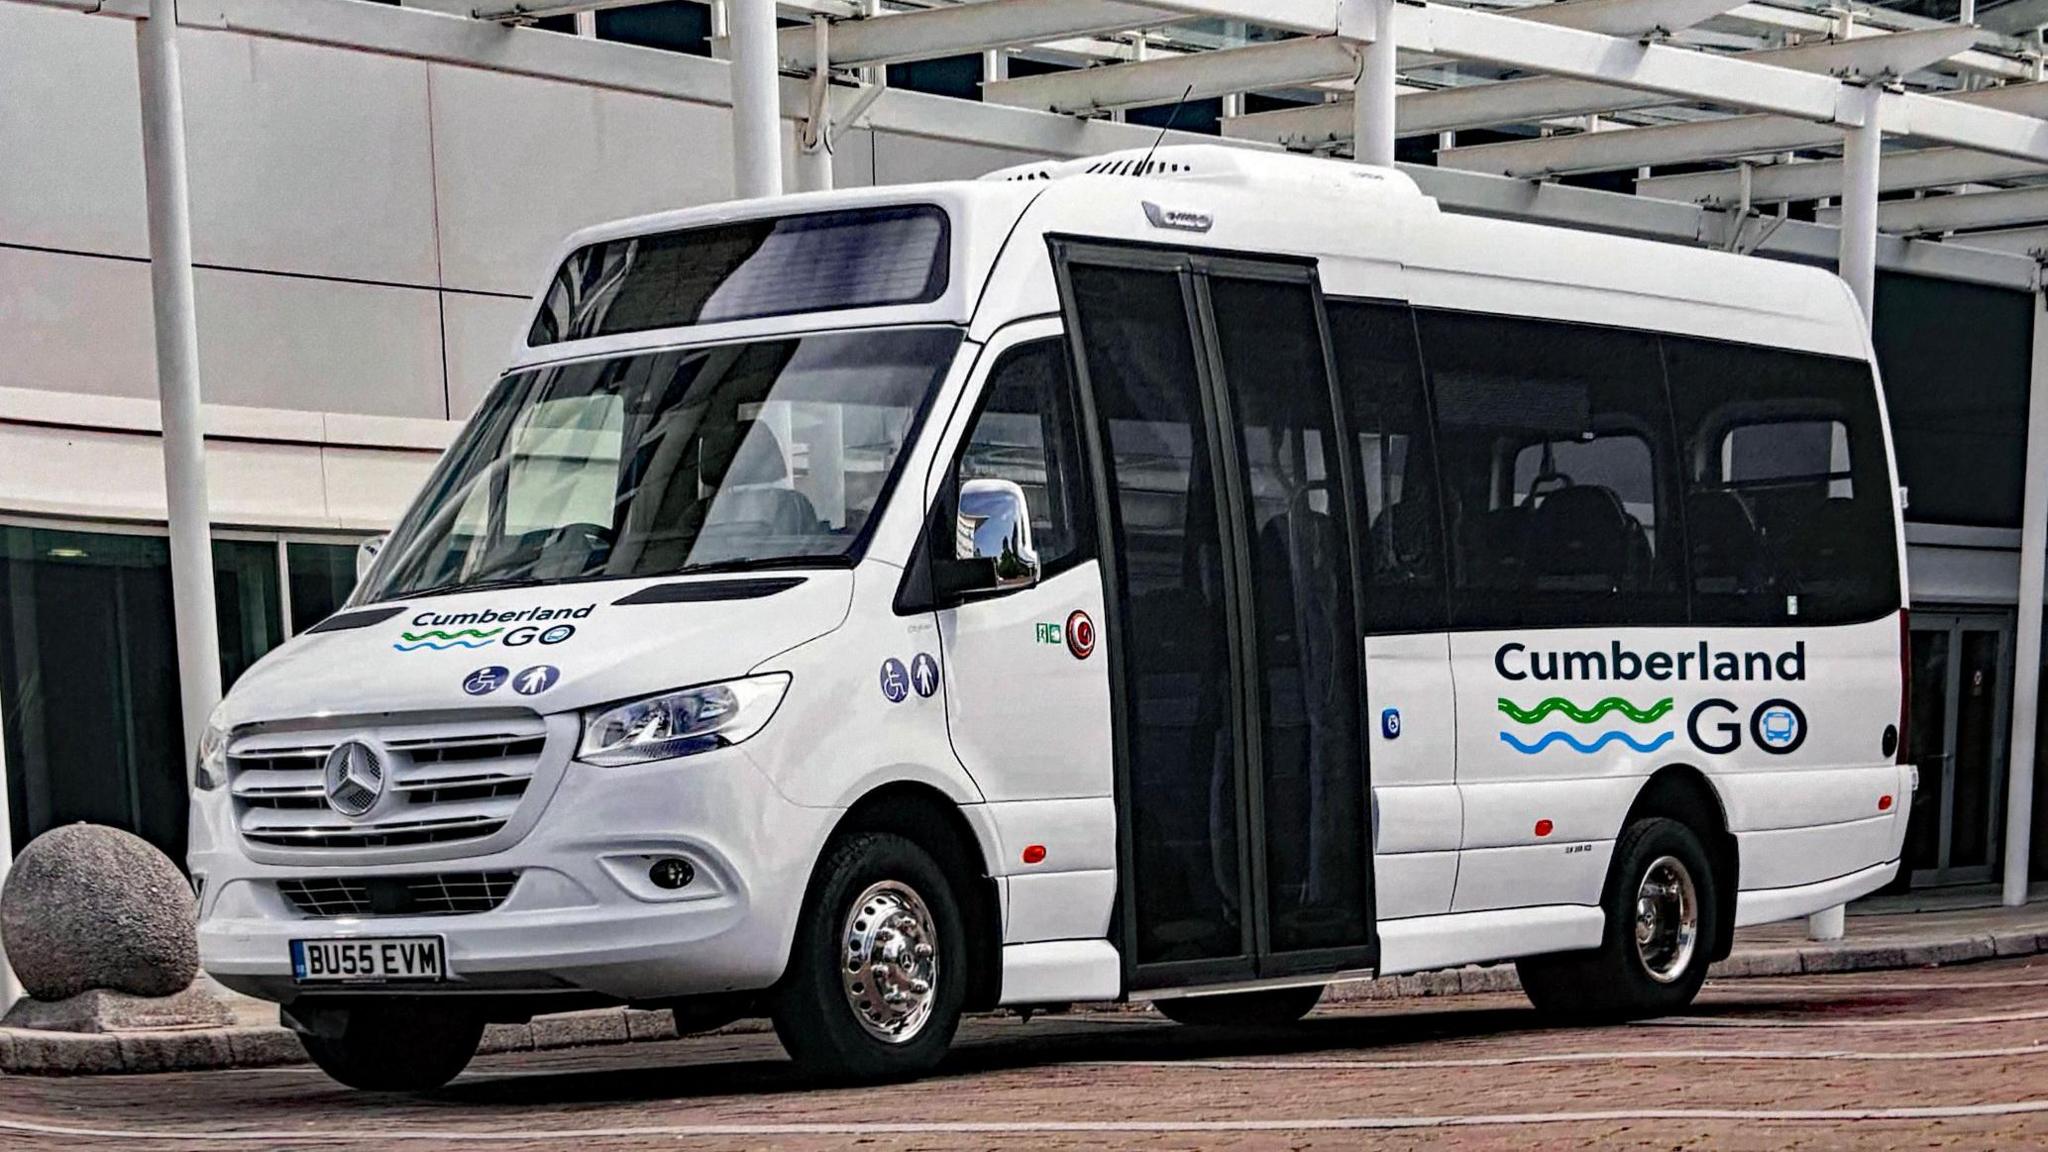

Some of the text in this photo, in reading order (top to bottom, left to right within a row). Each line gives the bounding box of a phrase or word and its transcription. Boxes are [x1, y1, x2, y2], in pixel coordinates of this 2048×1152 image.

[412, 603, 597, 627] Cumberland
[502, 624, 576, 647] GO
[1494, 640, 1806, 681] Cumberland
[1686, 698, 1808, 755] GO
[308, 943, 437, 975] BU55 EVM
